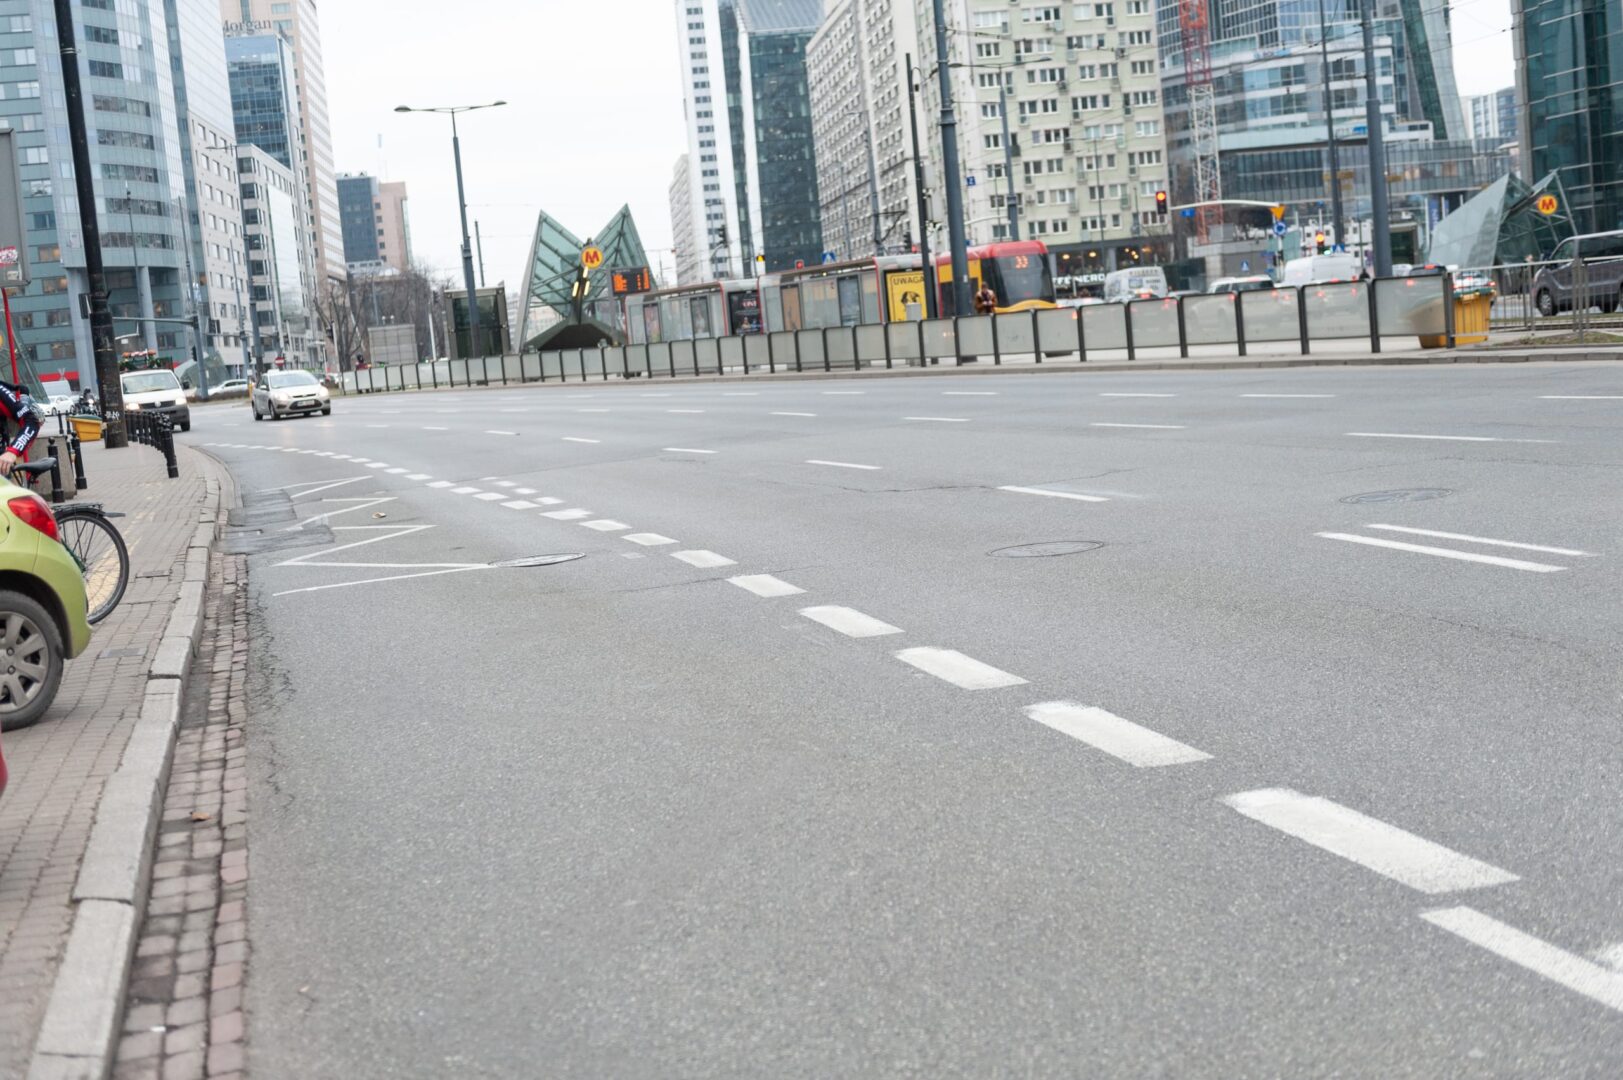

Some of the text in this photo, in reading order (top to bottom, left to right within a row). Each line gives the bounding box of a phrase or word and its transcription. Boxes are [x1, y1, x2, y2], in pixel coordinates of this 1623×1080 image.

[1542, 198, 1555, 210] M
[585, 250, 600, 264] M
[12, 426, 35, 451] BMC
